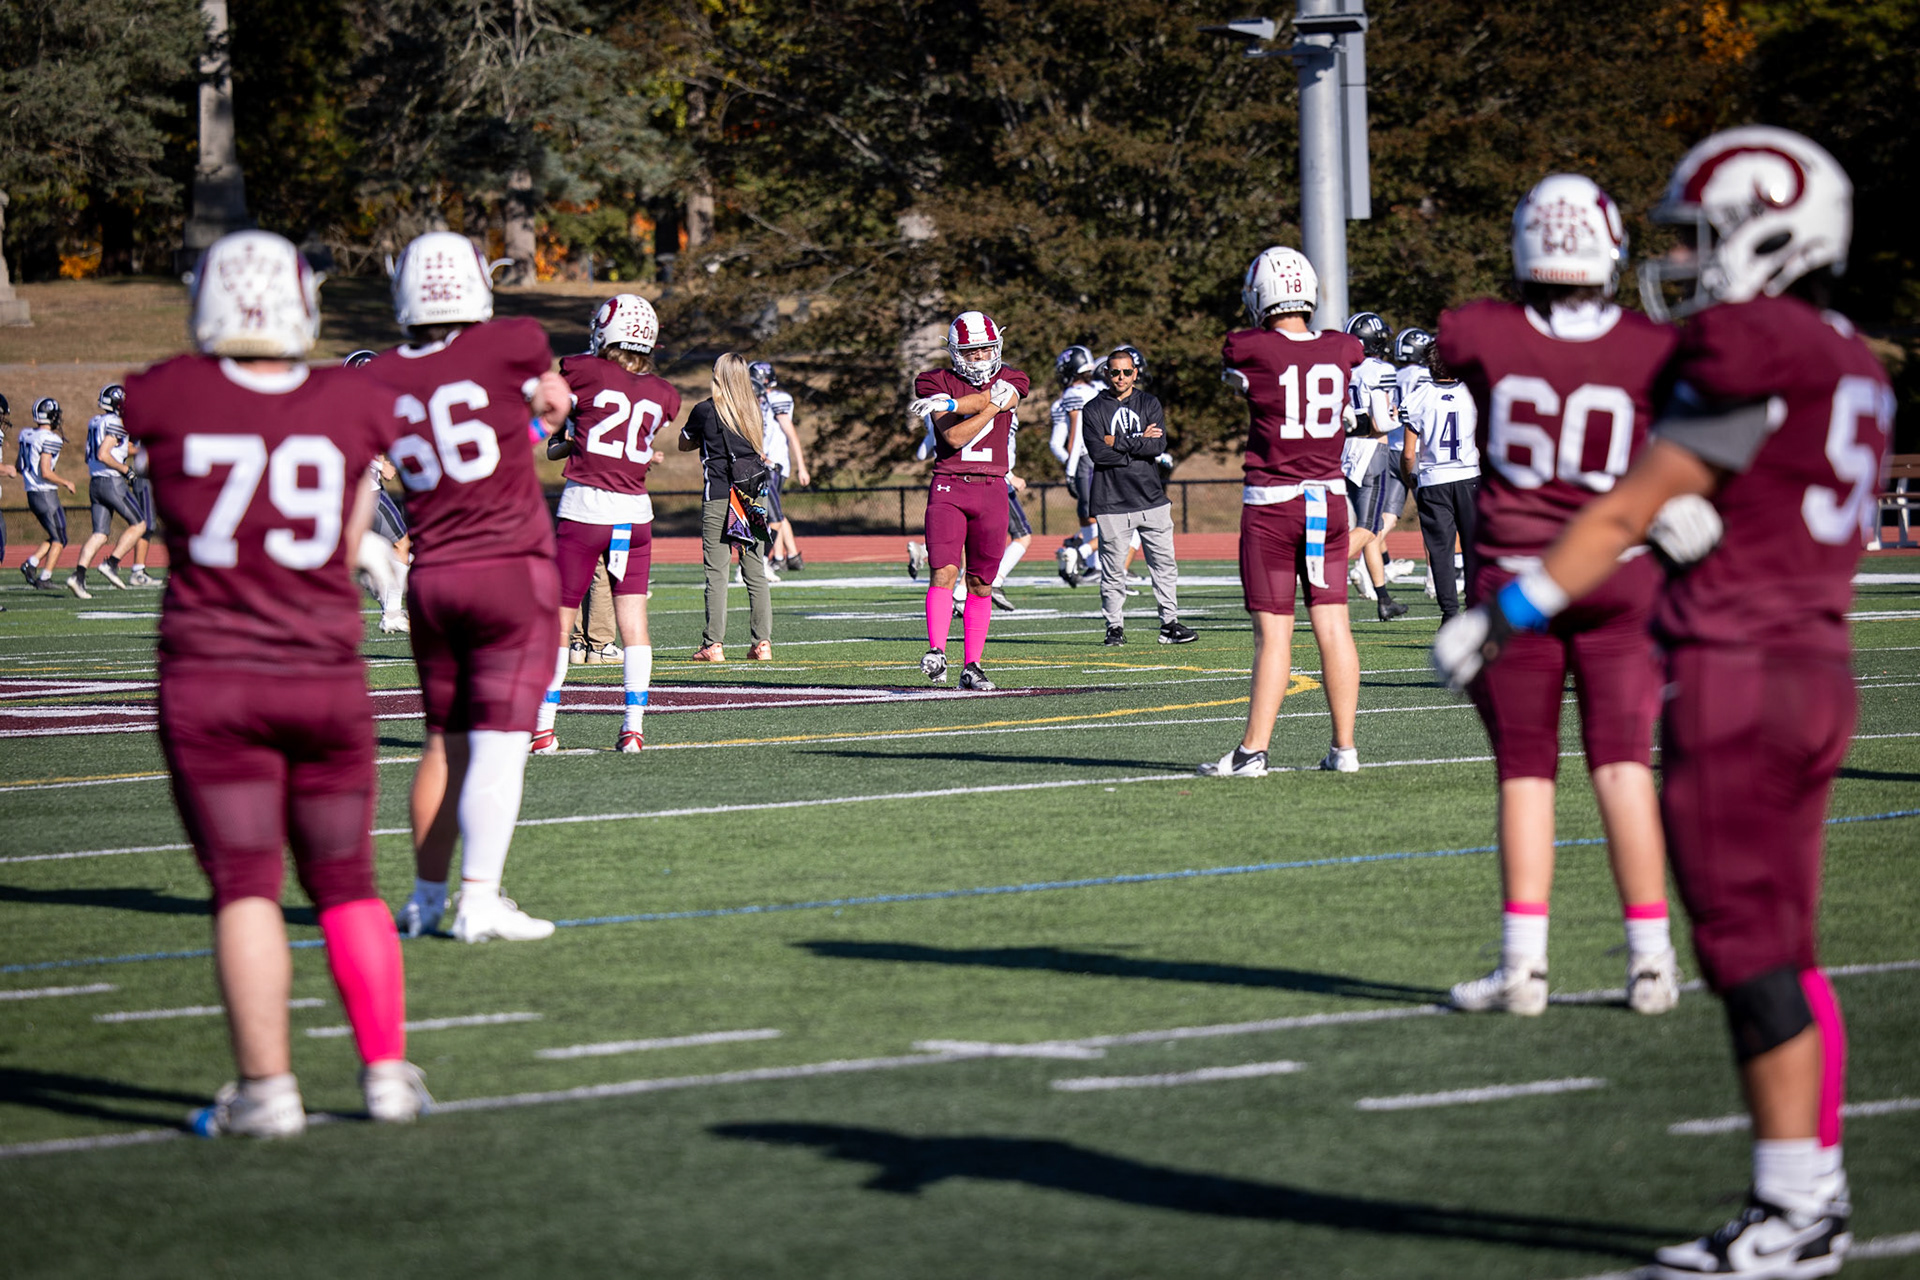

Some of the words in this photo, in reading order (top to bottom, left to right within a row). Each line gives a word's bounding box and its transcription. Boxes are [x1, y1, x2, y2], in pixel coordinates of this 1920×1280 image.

[620, 341, 651, 354] Riddell
[1367, 318, 1383, 331] 10
[388, 380, 500, 492] 66
[586, 389, 663, 465] 20
[1279, 363, 1344, 439] 18
[1439, 411, 1462, 460] 4
[1488, 373, 1635, 492] 60
[1801, 374, 1898, 546] 5
[183, 433, 346, 570] 79
